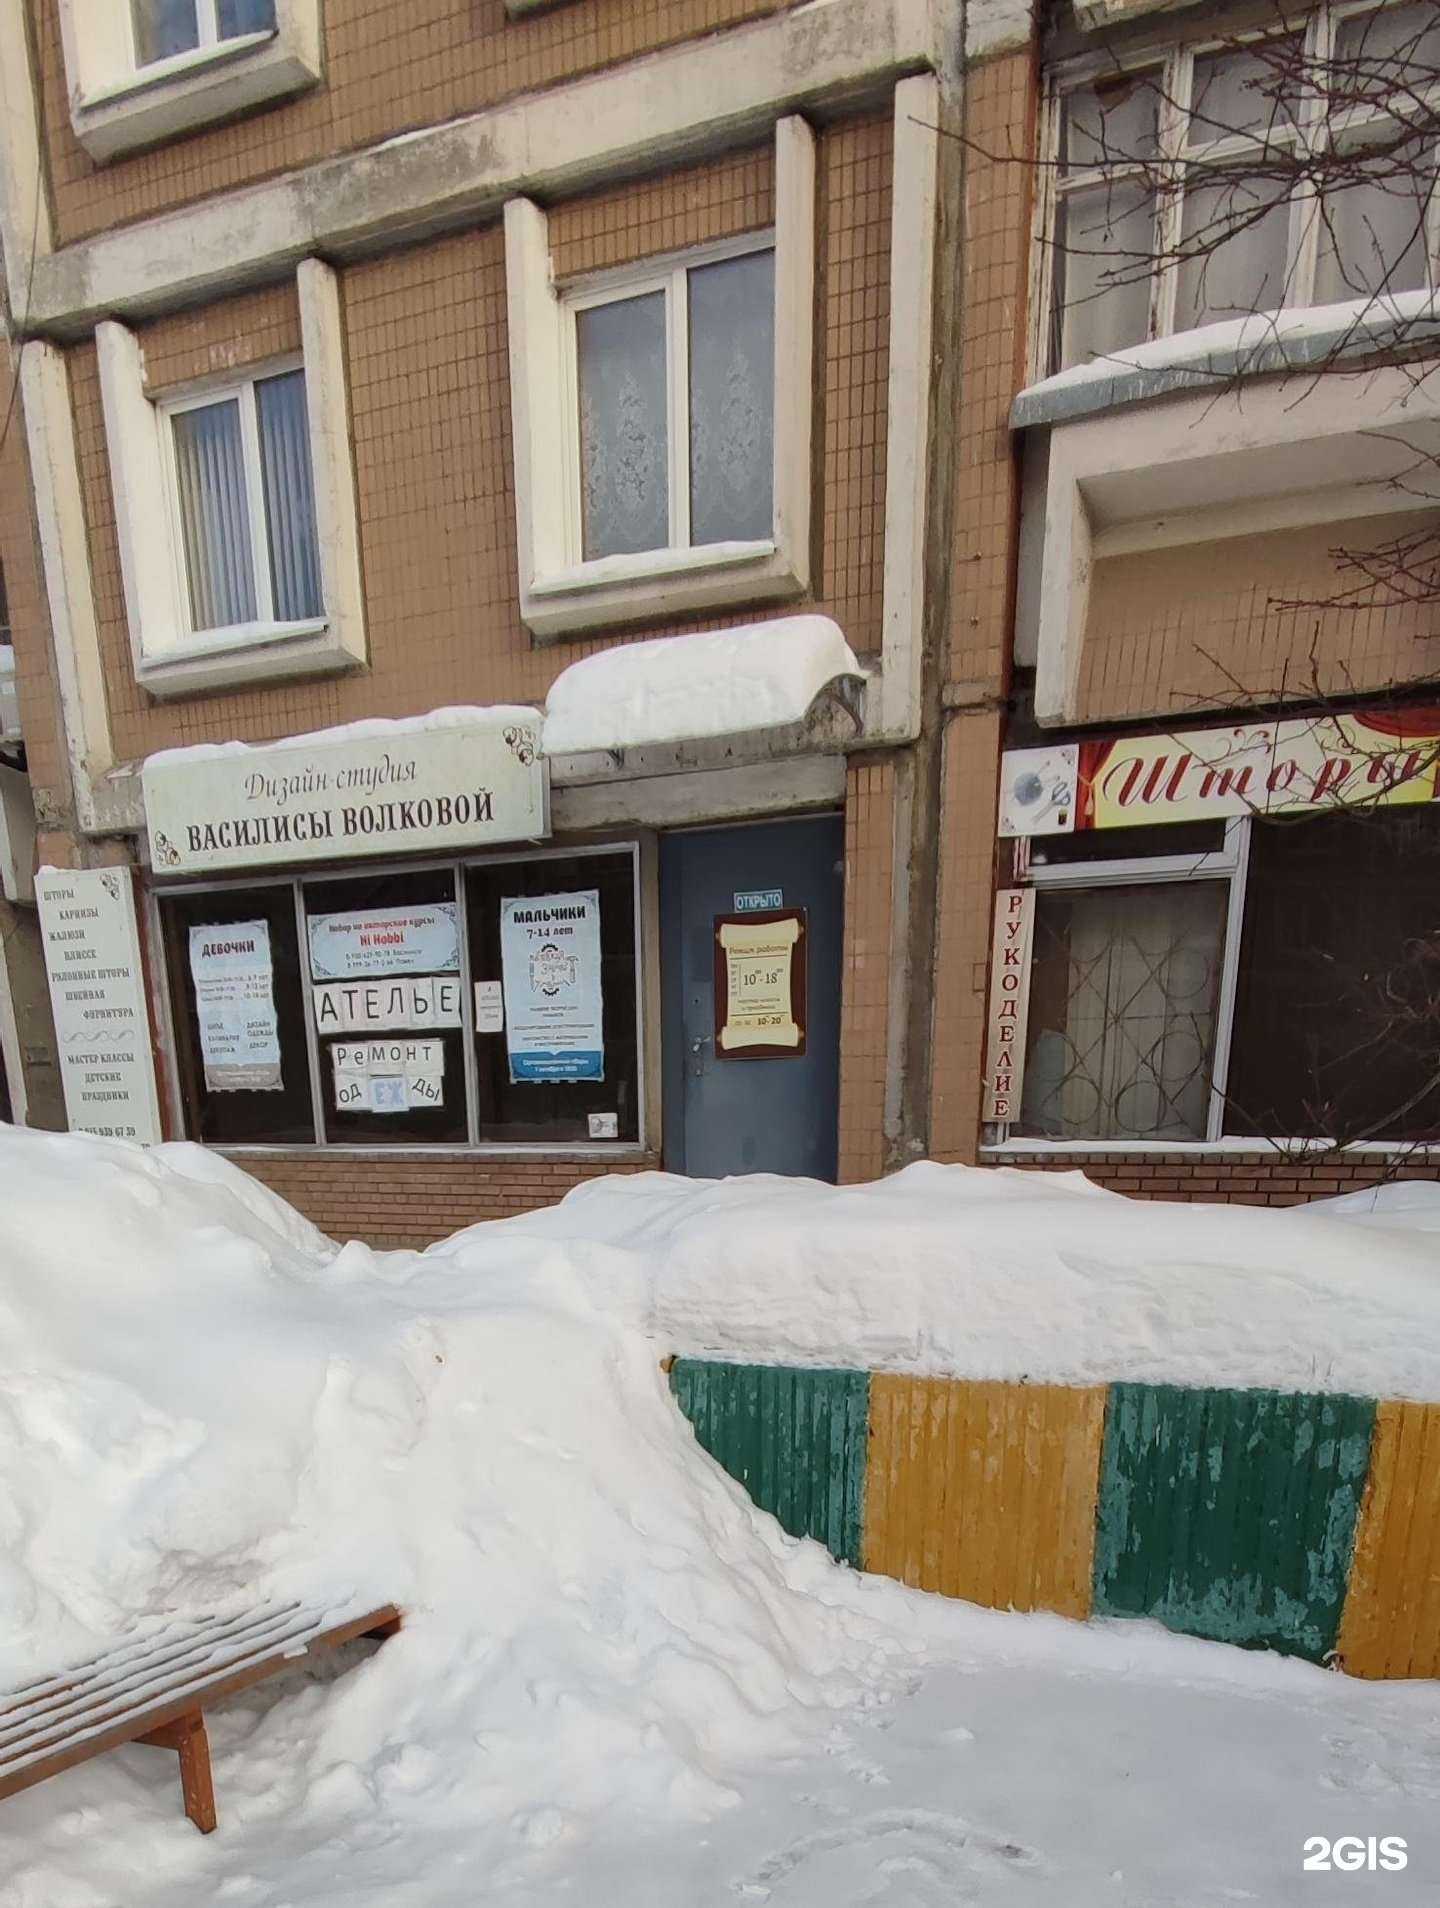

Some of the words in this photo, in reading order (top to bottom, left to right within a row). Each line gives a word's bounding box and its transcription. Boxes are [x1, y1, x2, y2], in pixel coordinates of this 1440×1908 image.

[244, 754, 417, 805] Дизайн-студия
[187, 808, 332, 852] ВАСИЛИСЫ
[342, 787, 495, 836] ВОЛКОВОЙ
[43, 889, 75, 901] ШТОРЫ
[736, 893, 781, 910] ОТКРЫТО
[59, 908, 99, 920] КАРНИЗЫ
[513, 906, 586, 923] МАЛЬЧИКИ
[49, 929, 85, 941] ЖАЛЮЗИ
[526, 928, 550, 939] 7-14
[63, 949, 97, 961] ПЛИССЕ
[202, 940, 255, 959] ДЕВОЧКИ
[52, 970, 97, 982] РУЛОННЫЕ
[98, 967, 130, 979] ШТОРЫ
[65, 989, 105, 1001] ШВЕЙНАЯ
[320, 985, 453, 1023] АТЕЛЬЕ
[993, 895, 1022, 1116] РУКОДЕЛИЕ
[82, 1007, 135, 1019] ФУРНИТУРА
[67, 1053, 99, 1065] МАСТЕР
[100, 1053, 135, 1063] КЛАССЫ
[85, 1072, 122, 1083] ДЕТСКИЕ
[81, 1091, 130, 1103] ПРАЗДНИКИ
